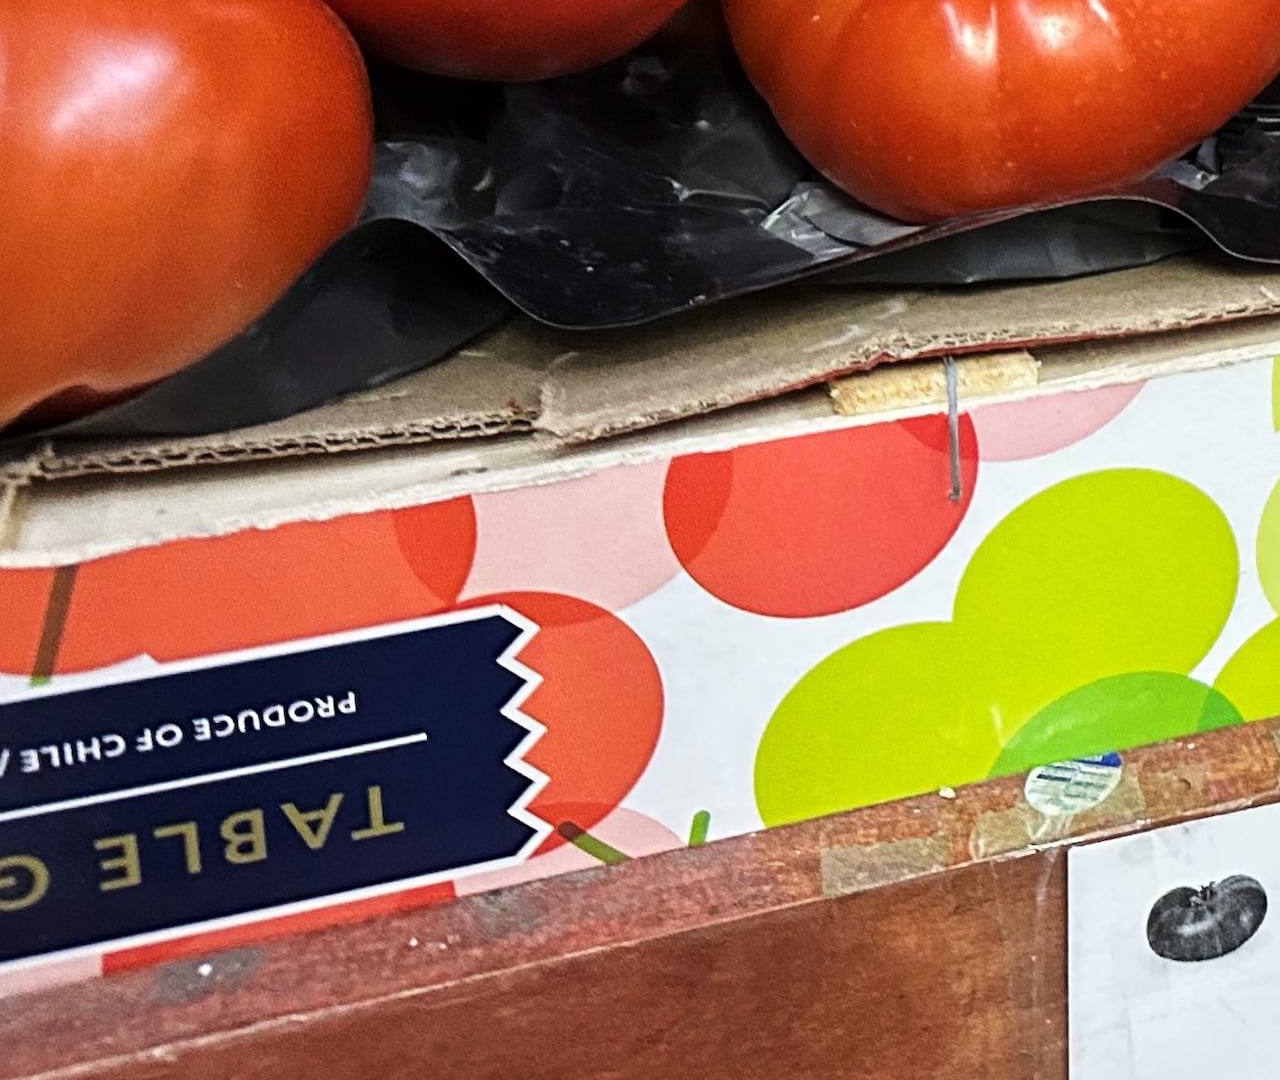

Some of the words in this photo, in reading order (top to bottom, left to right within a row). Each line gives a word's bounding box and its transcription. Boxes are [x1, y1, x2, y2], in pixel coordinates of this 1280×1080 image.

[136, 723, 183, 752] OF
[192, 690, 358, 742] PRODUCE
[20, 733, 126, 773] CHILE
[94, 785, 405, 892] TABLE
